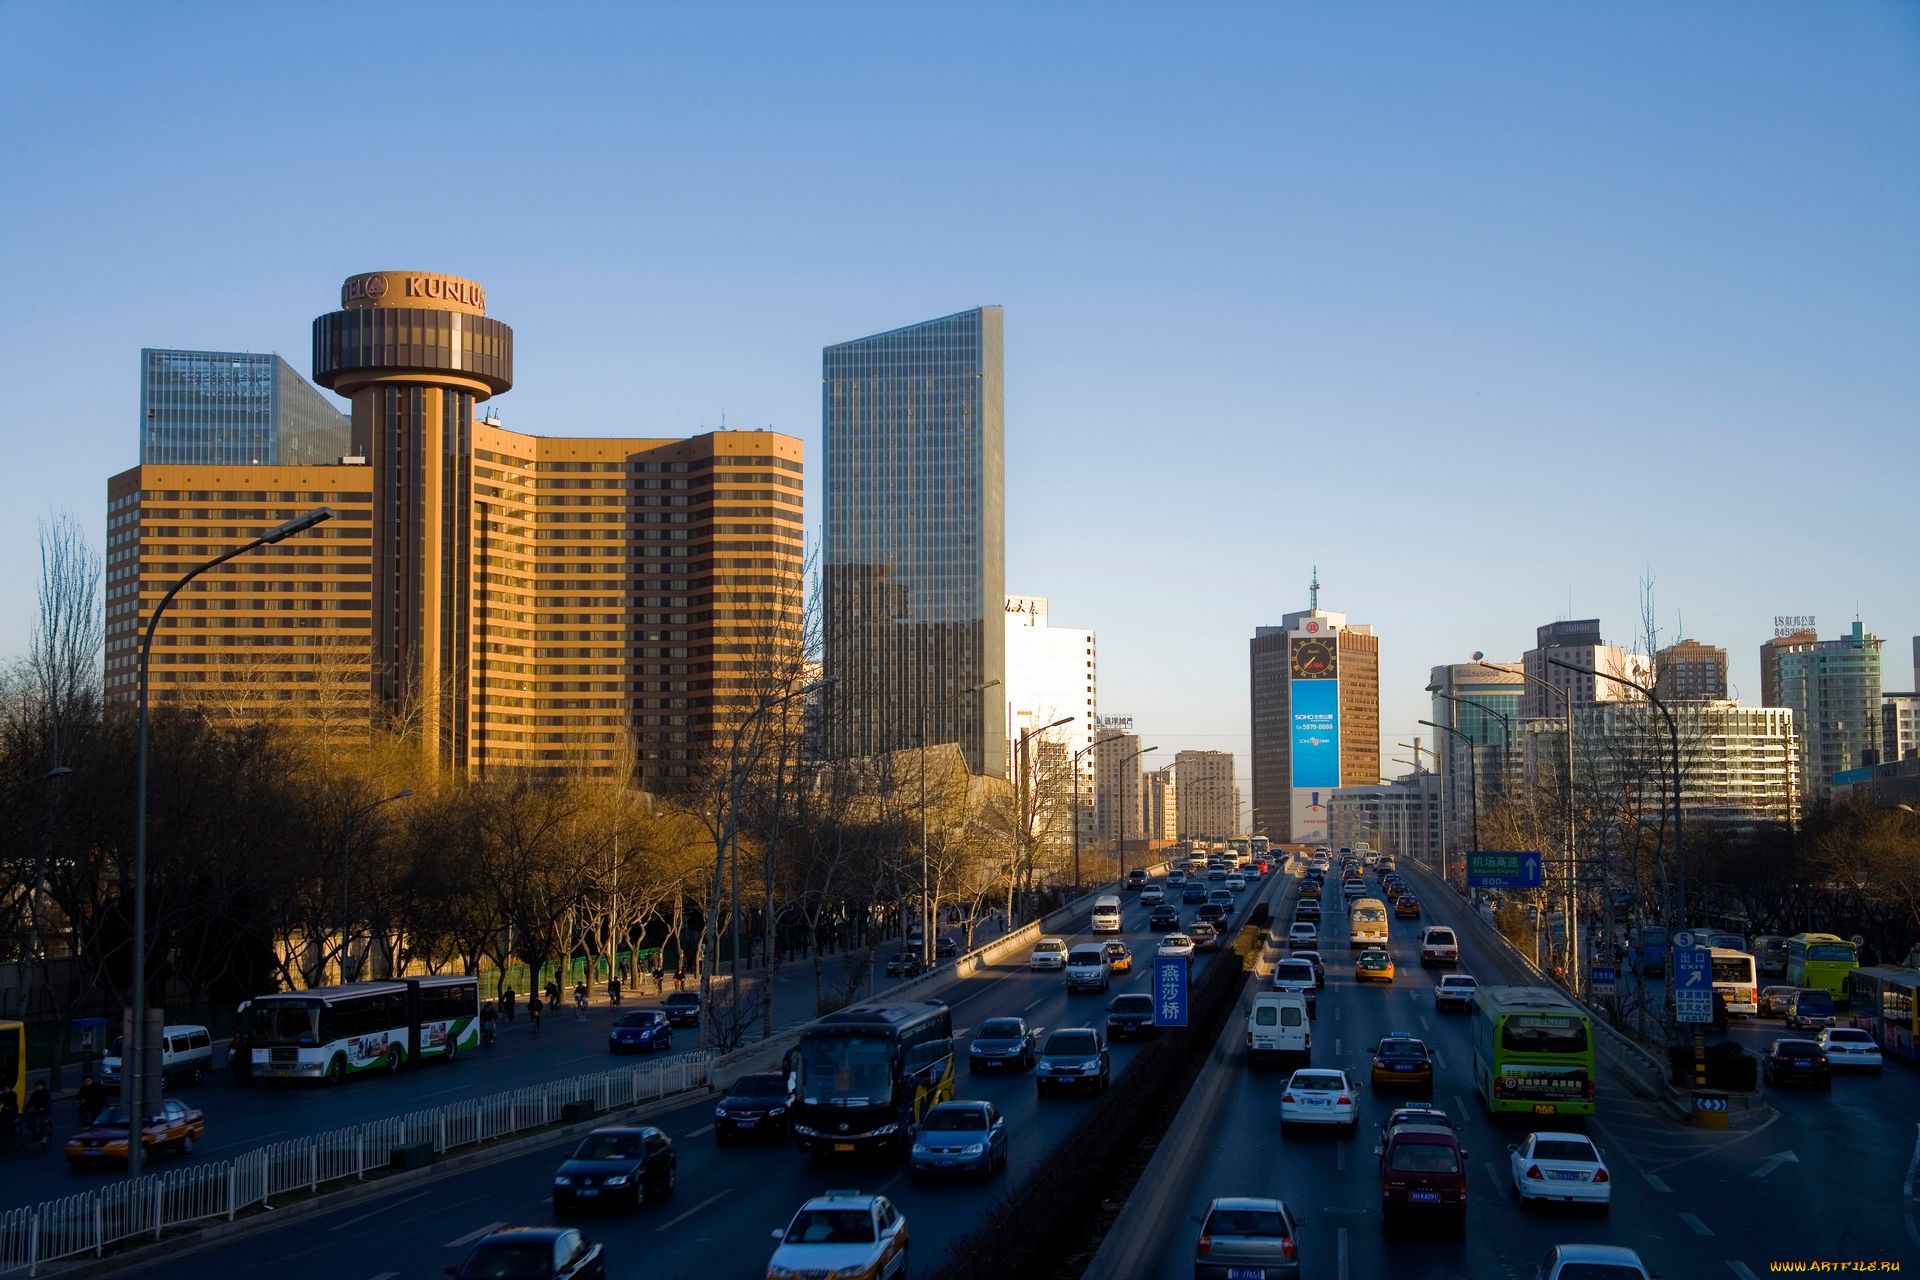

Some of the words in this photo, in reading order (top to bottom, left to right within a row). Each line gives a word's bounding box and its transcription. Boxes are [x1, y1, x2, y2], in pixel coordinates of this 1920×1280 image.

[1473, 856, 1520, 868] 机场高速
[1482, 877, 1509, 886] 800m
[1680, 934, 1688, 945] 5
[1680, 952, 1705, 964] 出口
[1161, 964, 1180, 1020] 燕莎桥
